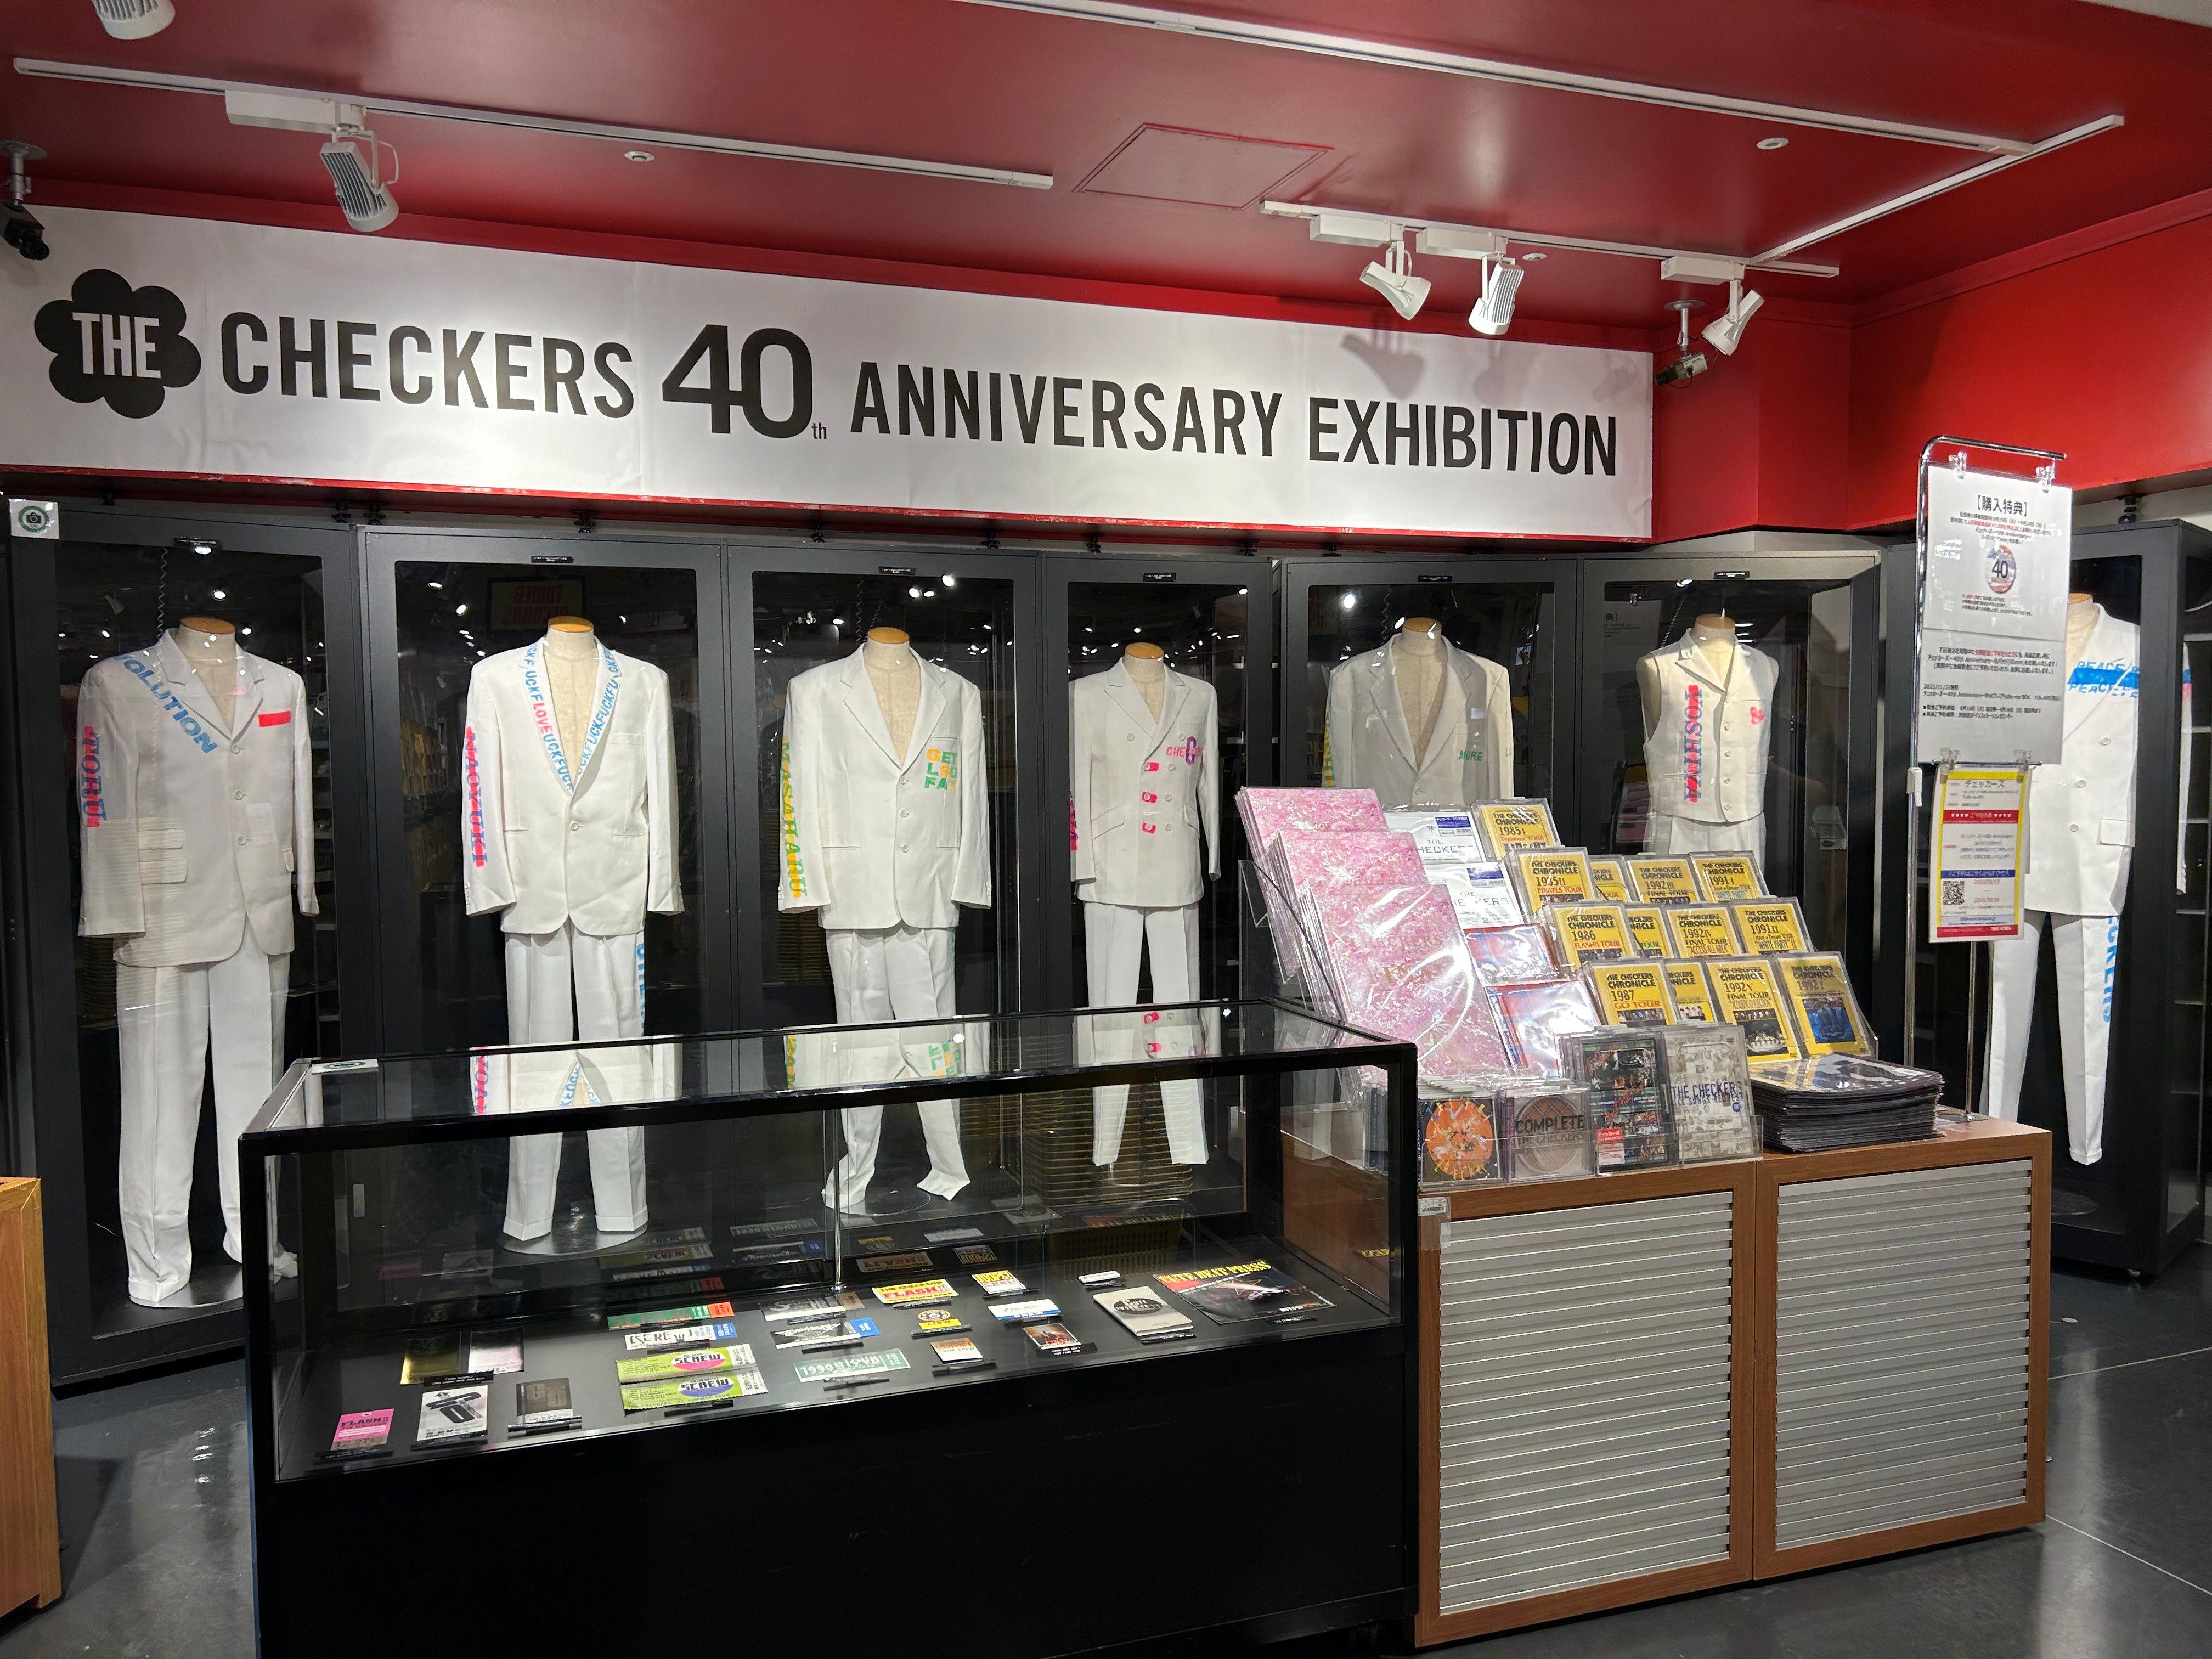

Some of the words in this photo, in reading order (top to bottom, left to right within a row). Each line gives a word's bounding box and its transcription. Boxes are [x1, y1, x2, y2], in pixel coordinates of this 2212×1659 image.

[72, 312, 162, 379] THE
[221, 312, 634, 418] CHECKERS
[851, 362, 1282, 457] ANNIVERSARY
[1309, 397, 1616, 476] EXHIBITION
[926, 748, 958, 764] GET
[1964, 780, 2005, 788] チェッカーズ
[1498, 826, 1521, 835] 1985
[1581, 914, 1613, 922] CHECKERS
[1679, 919, 1722, 928] CHRONICLE
[1747, 915, 1789, 923] CHRONICLE
[1568, 921, 1616, 929] CHRONICLE
[1571, 930, 1596, 941] 1986
[1607, 979, 1656, 989] CHRONICLE
[1611, 990, 1635, 1002] 1987
[1614, 1001, 1630, 1009] GO
[1632, 1000, 1662, 1008] TOUR
[1671, 1086, 1689, 1101] THE
[1692, 1081, 1743, 1098] CHECKERS
[1517, 1114, 1584, 1133] COMPLETE
[1157, 1273, 1198, 1284] CUTE
[1226, 1261, 1272, 1274] PRESS
[899, 1280, 943, 1290] CHECKERS
[882, 1285, 949, 1300] FLASH!!
[674, 1353, 721, 1364] SCREW
[800, 1363, 833, 1376] 1990
[681, 1378, 729, 1390] SCREW
